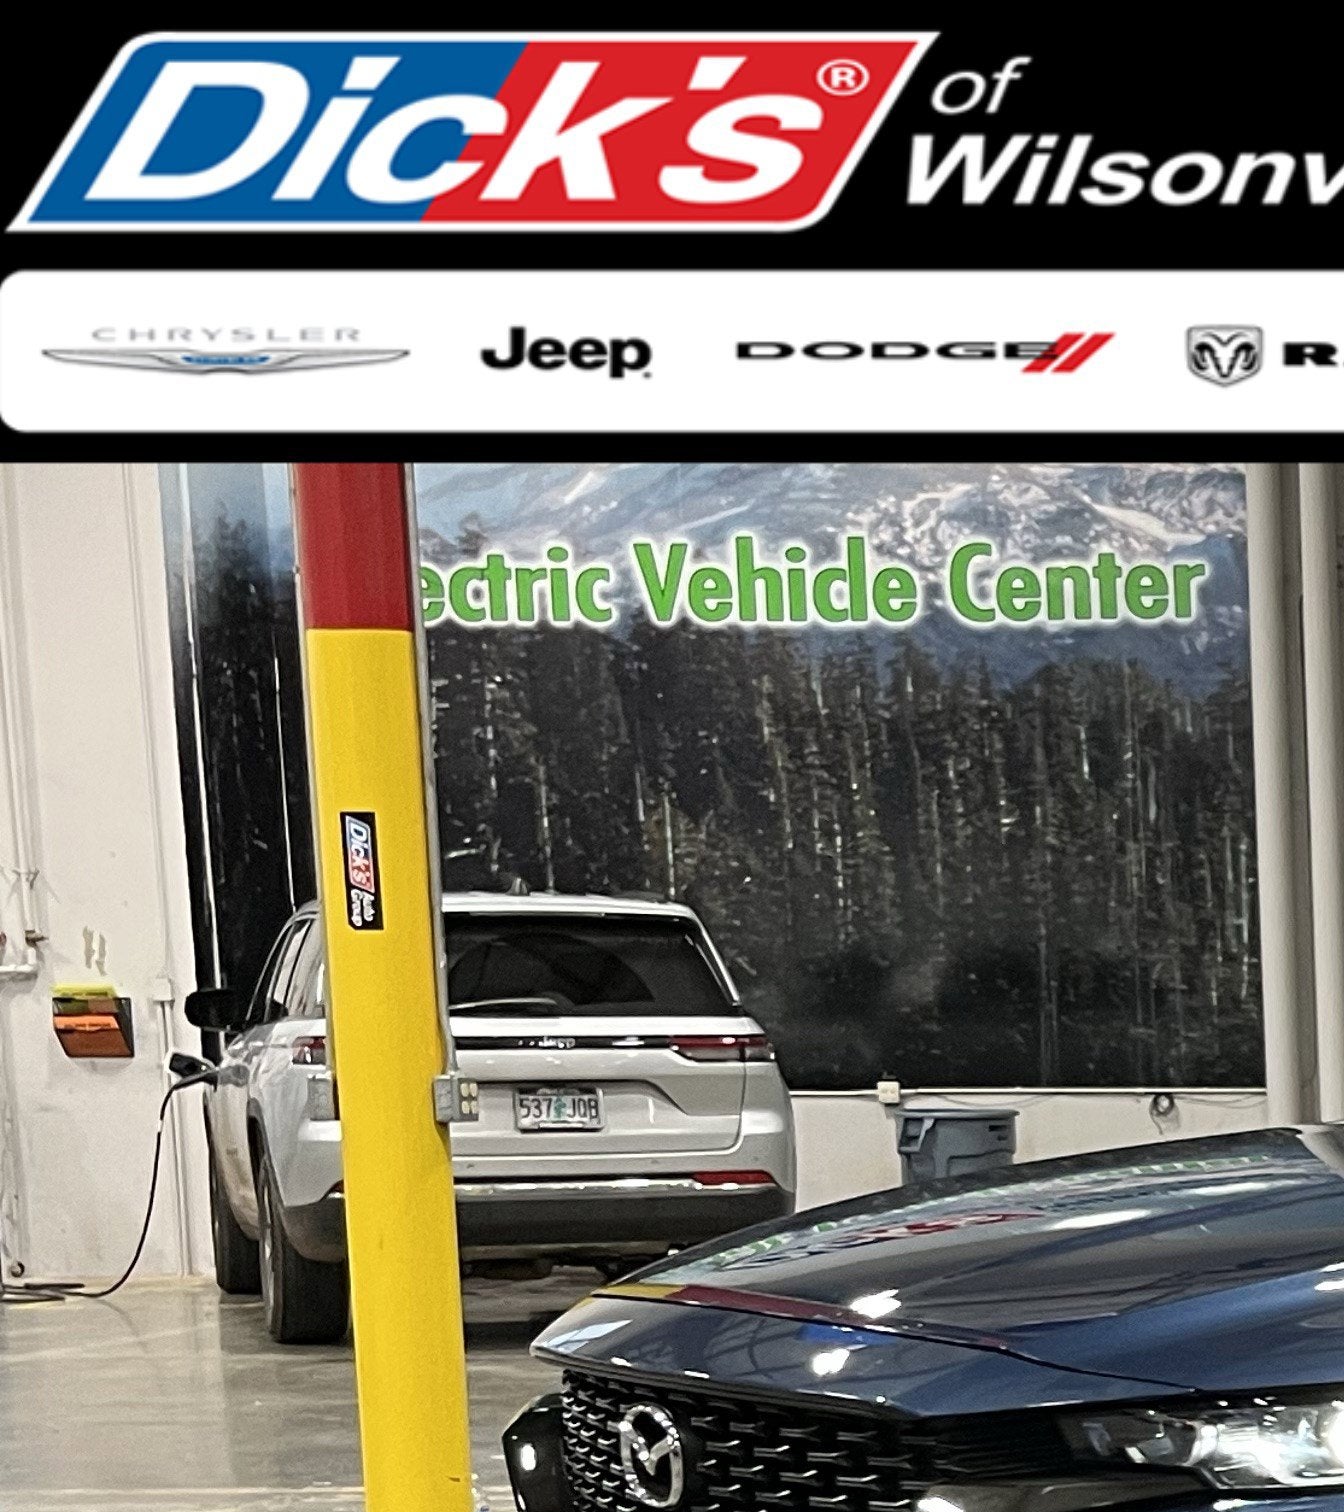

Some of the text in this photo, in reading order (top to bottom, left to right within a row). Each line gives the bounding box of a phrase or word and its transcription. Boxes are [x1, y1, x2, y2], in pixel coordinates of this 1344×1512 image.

[633, 535, 918, 624] Vehicle
[949, 541, 1208, 622] Center
[519, 1097, 552, 1119] 537
